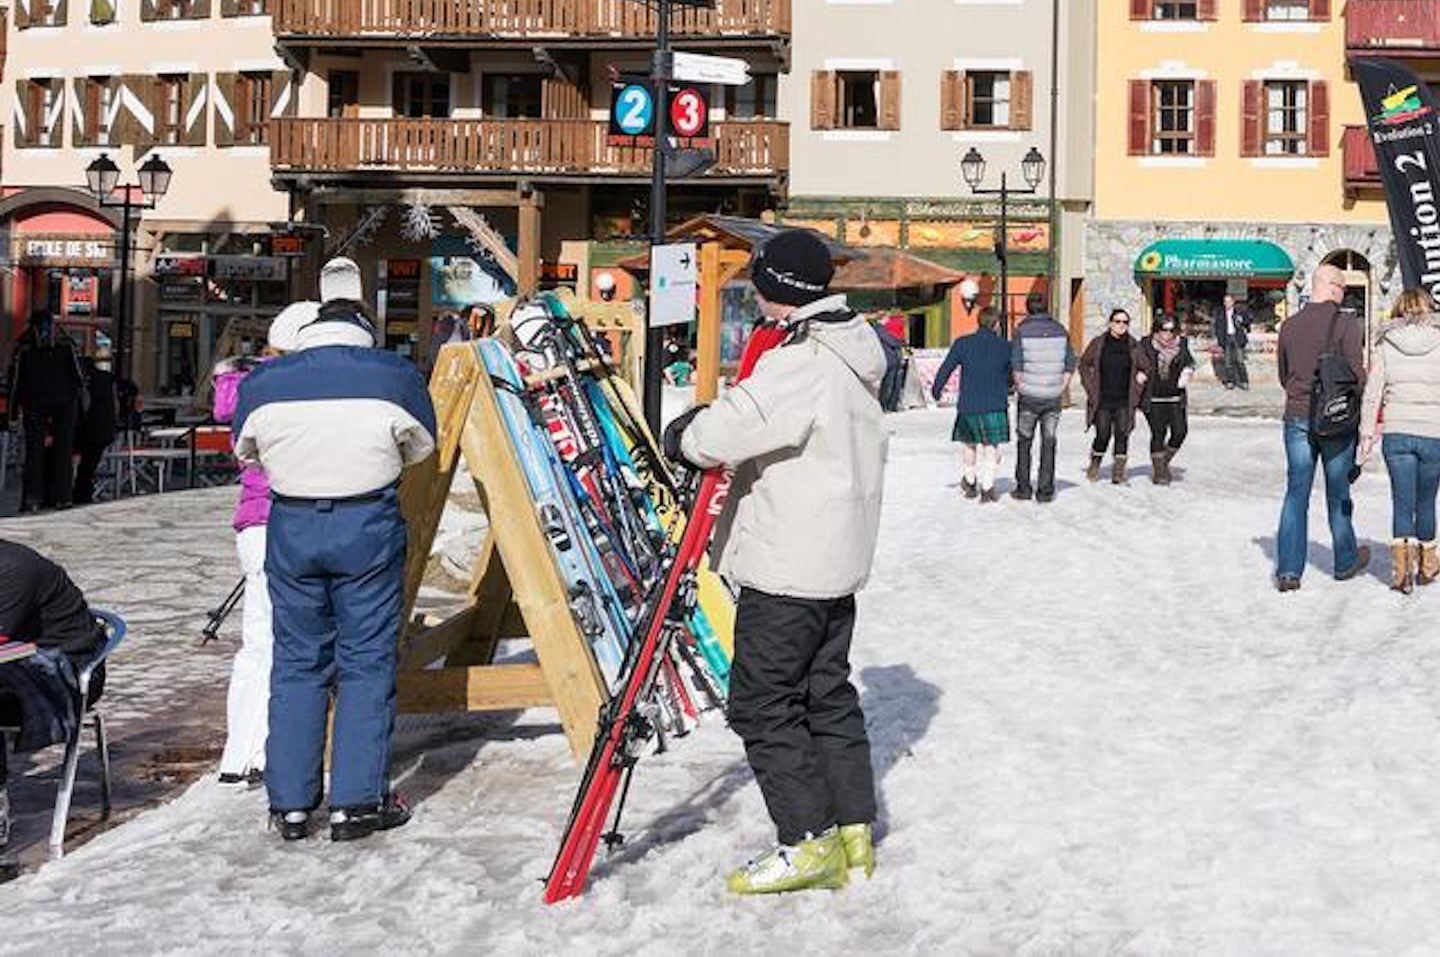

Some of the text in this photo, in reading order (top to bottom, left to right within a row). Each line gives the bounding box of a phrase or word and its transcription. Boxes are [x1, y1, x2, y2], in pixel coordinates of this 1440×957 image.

[621, 89, 646, 128] 2
[678, 93, 699, 131] 3
[1425, 122, 1433, 135] 2
[1394, 150, 1427, 174] 2
[66, 242, 82, 256] DE
[1164, 254, 1253, 270] Pharmastore
